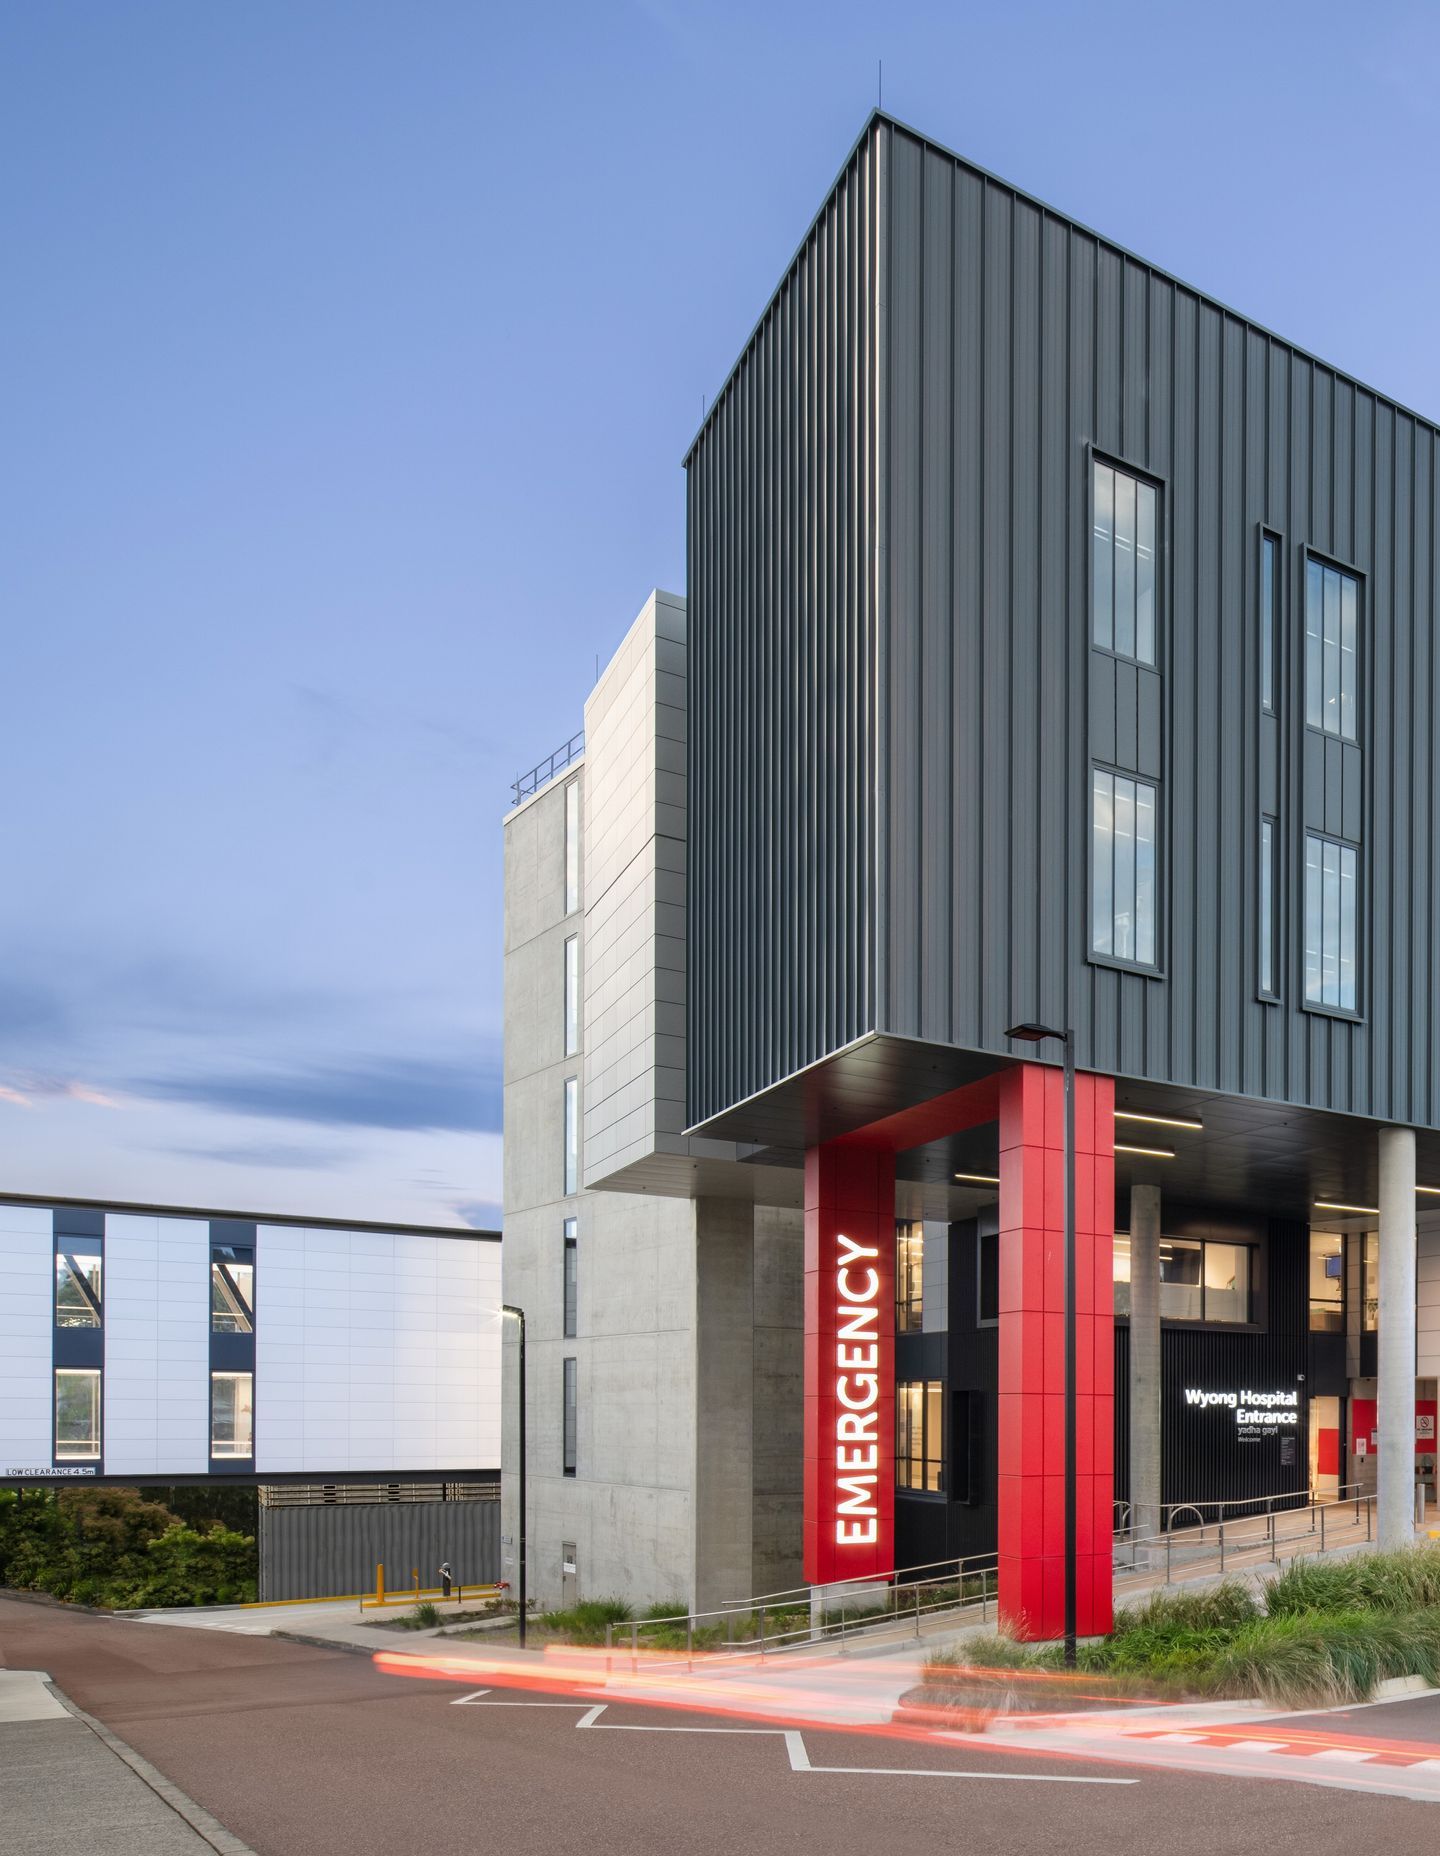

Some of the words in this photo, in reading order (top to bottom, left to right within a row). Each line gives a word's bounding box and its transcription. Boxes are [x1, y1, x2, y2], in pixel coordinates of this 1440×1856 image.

[836, 1234, 879, 1545] EMERGENCY
[1185, 1389, 1237, 1408] Wyong
[1240, 1390, 1297, 1408] Hospital
[1236, 1408, 1297, 1424] Entrance
[1238, 1426, 1260, 1435] yadha
[1262, 1426, 1278, 1435] gayi
[7, 1468, 23, 1476] LOW
[24, 1468, 71, 1476] CLEARANCE
